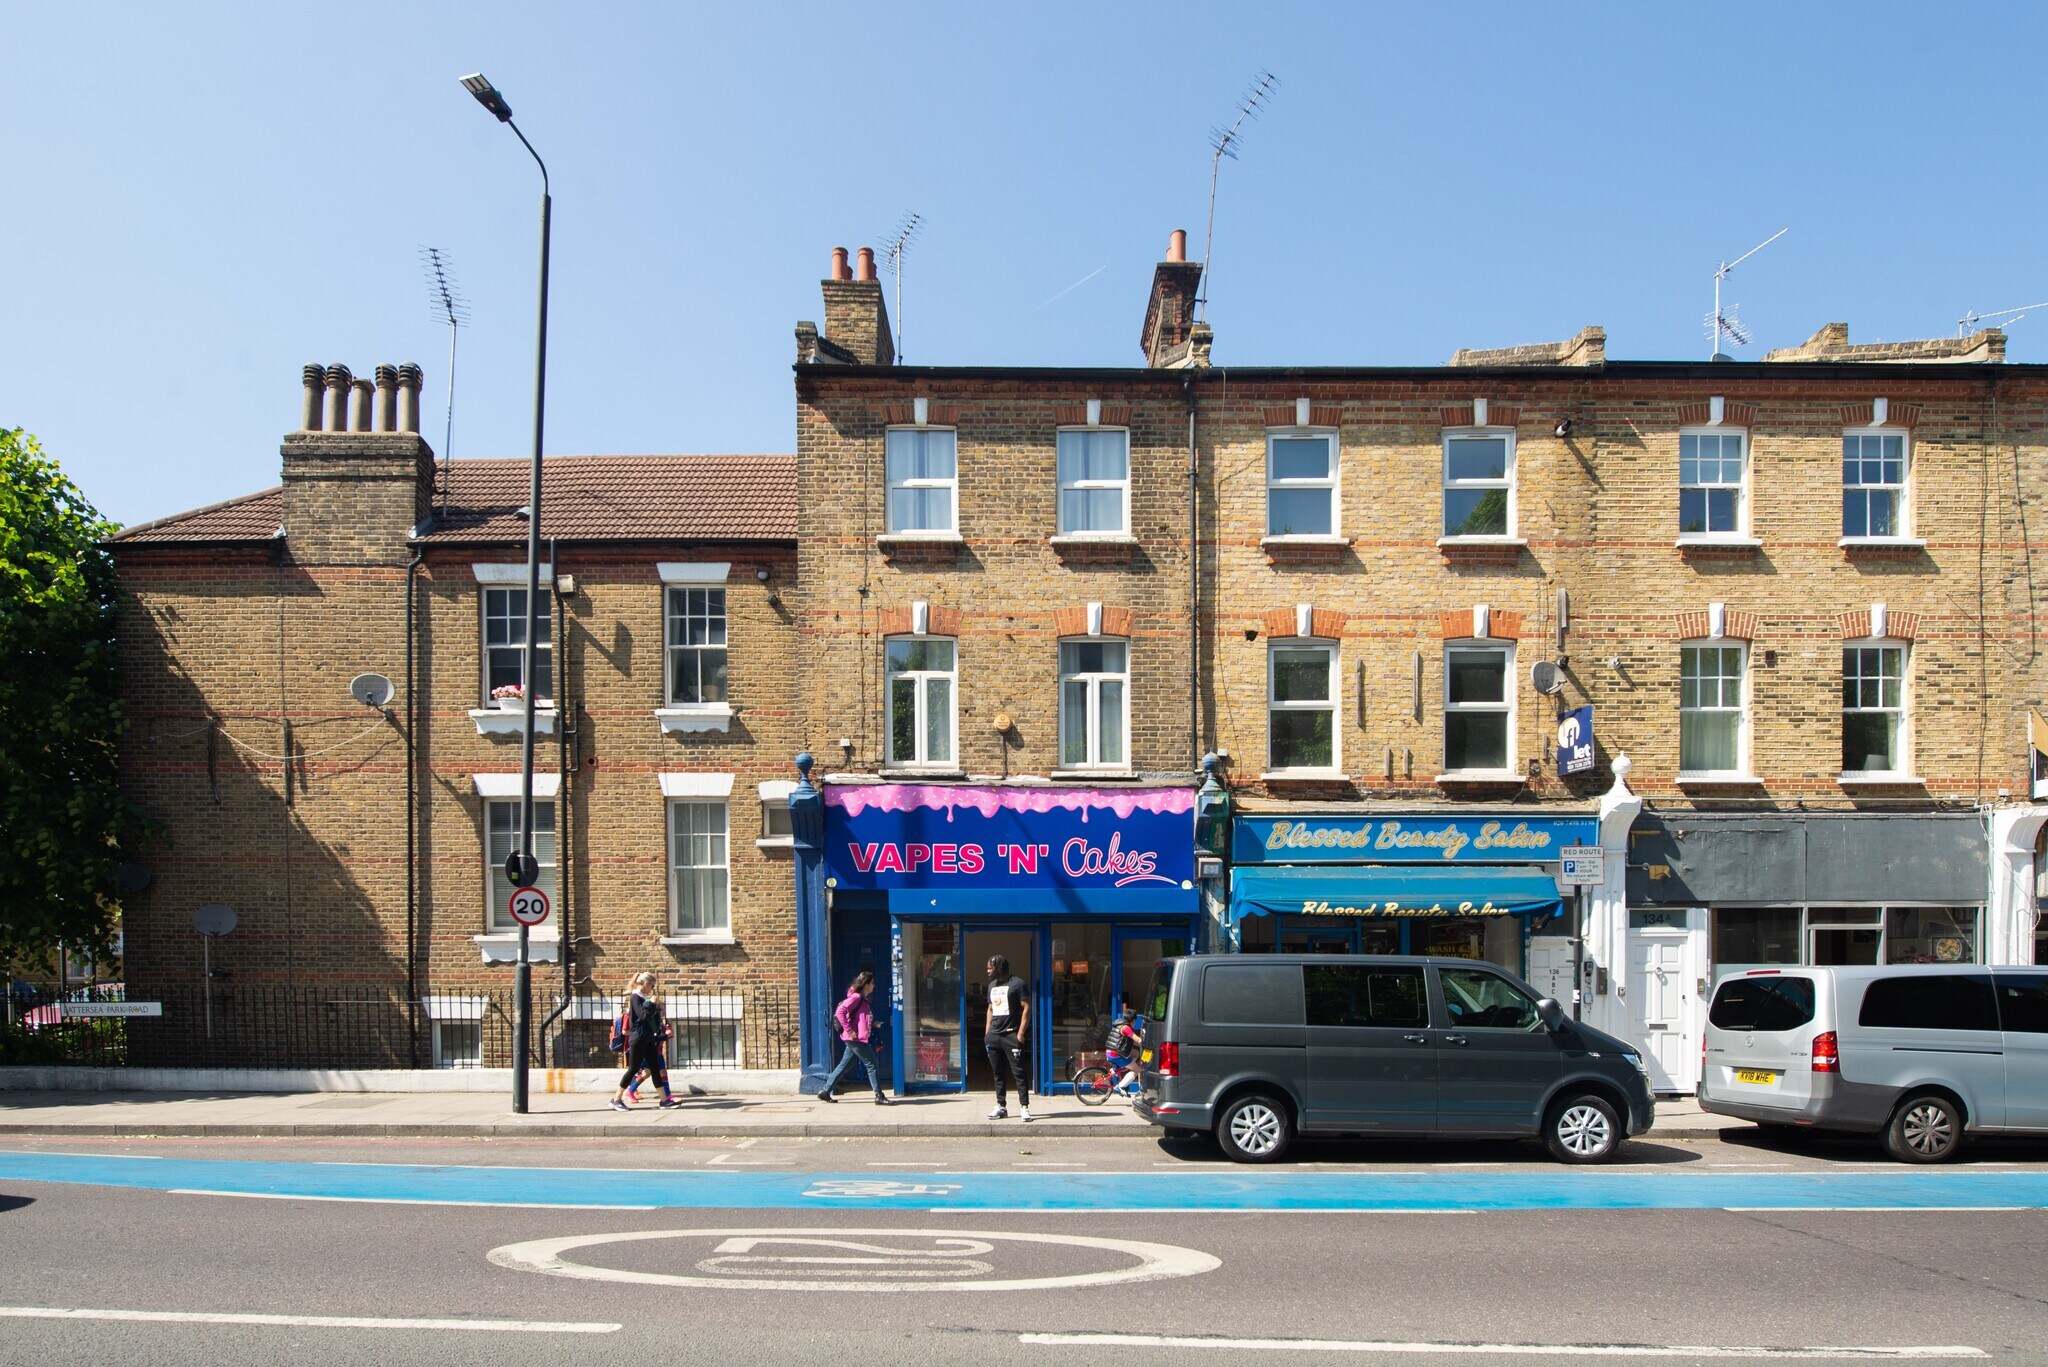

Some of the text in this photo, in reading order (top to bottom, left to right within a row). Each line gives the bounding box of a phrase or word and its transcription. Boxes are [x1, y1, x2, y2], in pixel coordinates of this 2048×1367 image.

[1574, 743, 1592, 759] let
[1266, 820, 1551, 860] Blessed Beauty Salon
[848, 831, 1157, 877] VAPES 'N' Cakes
[516, 899, 544, 914] 20
[1428, 945, 1456, 953] WASH
[63, 1005, 149, 1014] BATTERSEA PARK ROAD
